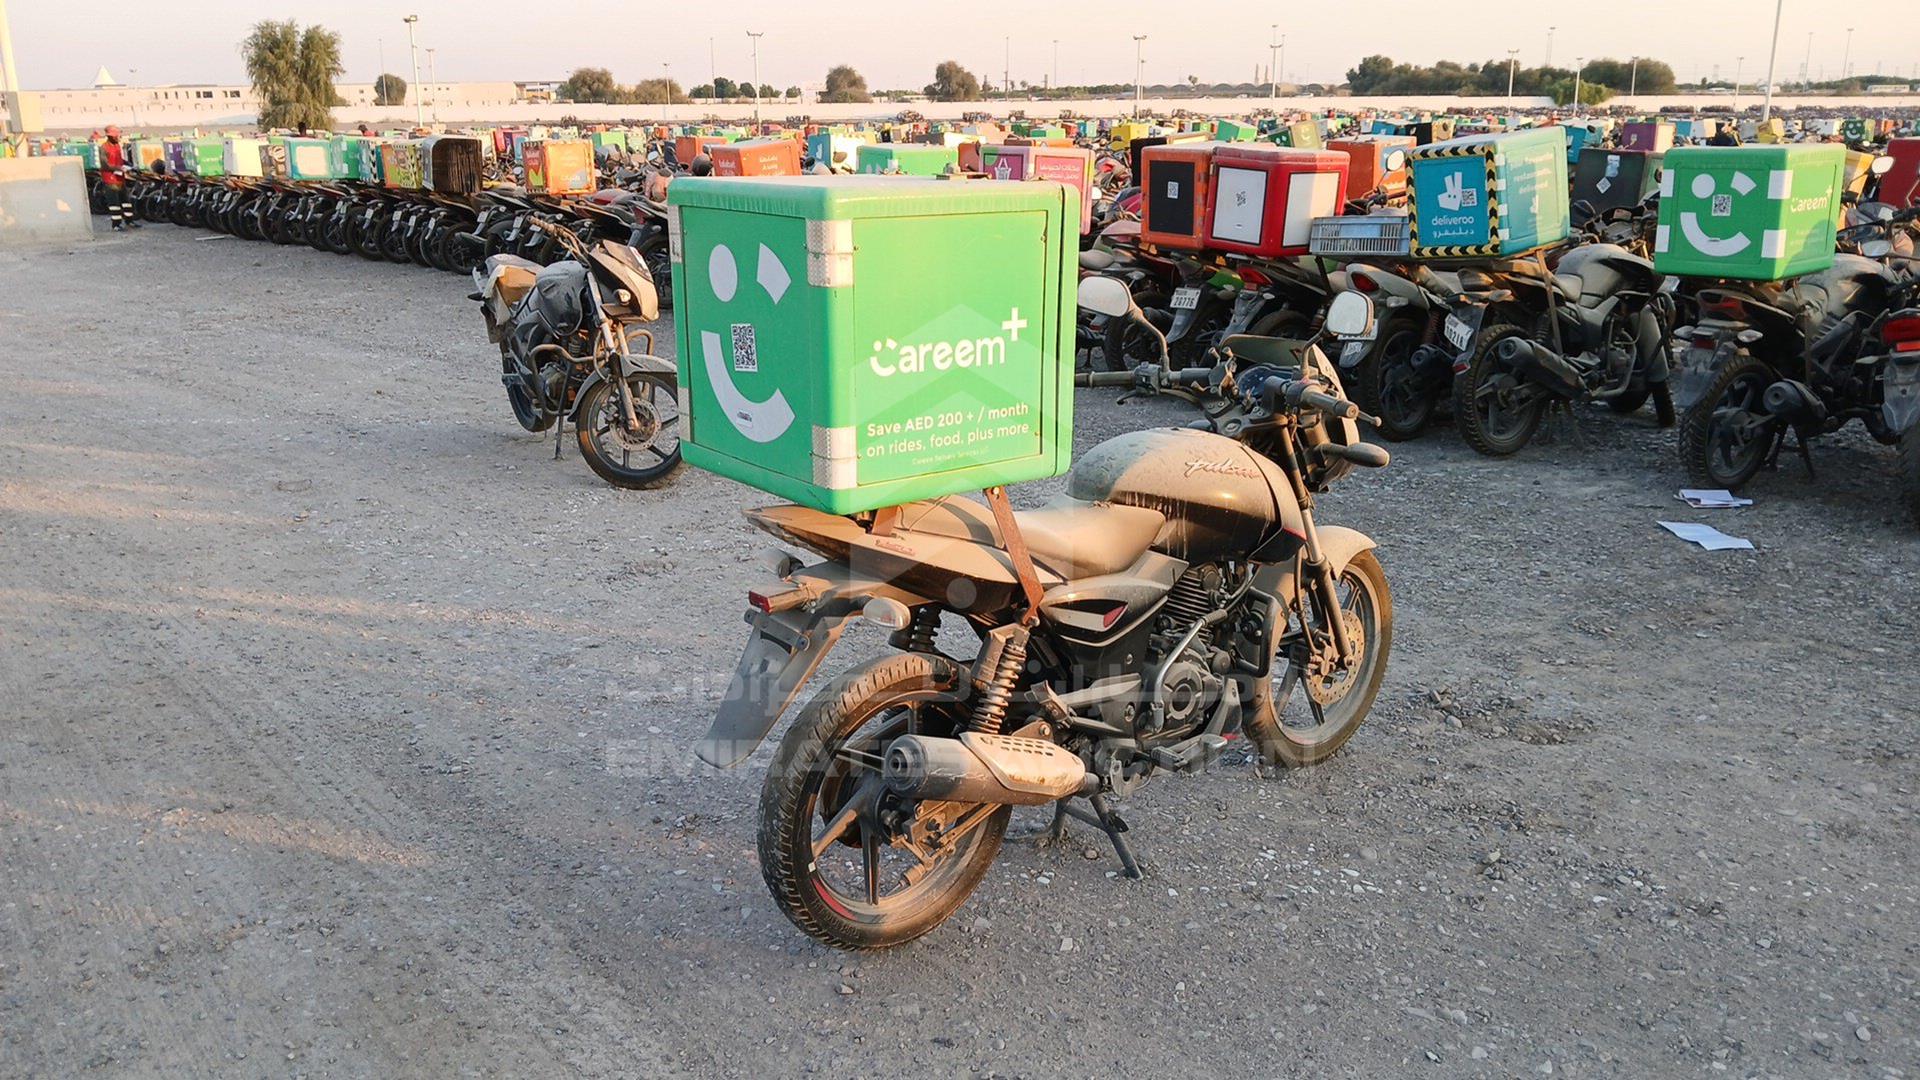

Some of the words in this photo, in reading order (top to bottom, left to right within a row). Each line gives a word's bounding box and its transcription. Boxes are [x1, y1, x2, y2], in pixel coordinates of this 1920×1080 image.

[1431, 215, 1475, 226] deliveroo
[867, 423, 901, 437] Save
[905, 416, 934, 432] AED
[937, 411, 963, 427] 200
[988, 402, 1029, 420] month
[866, 445, 885, 457] on
[968, 427, 994, 445] plus
[997, 423, 1029, 438] more
